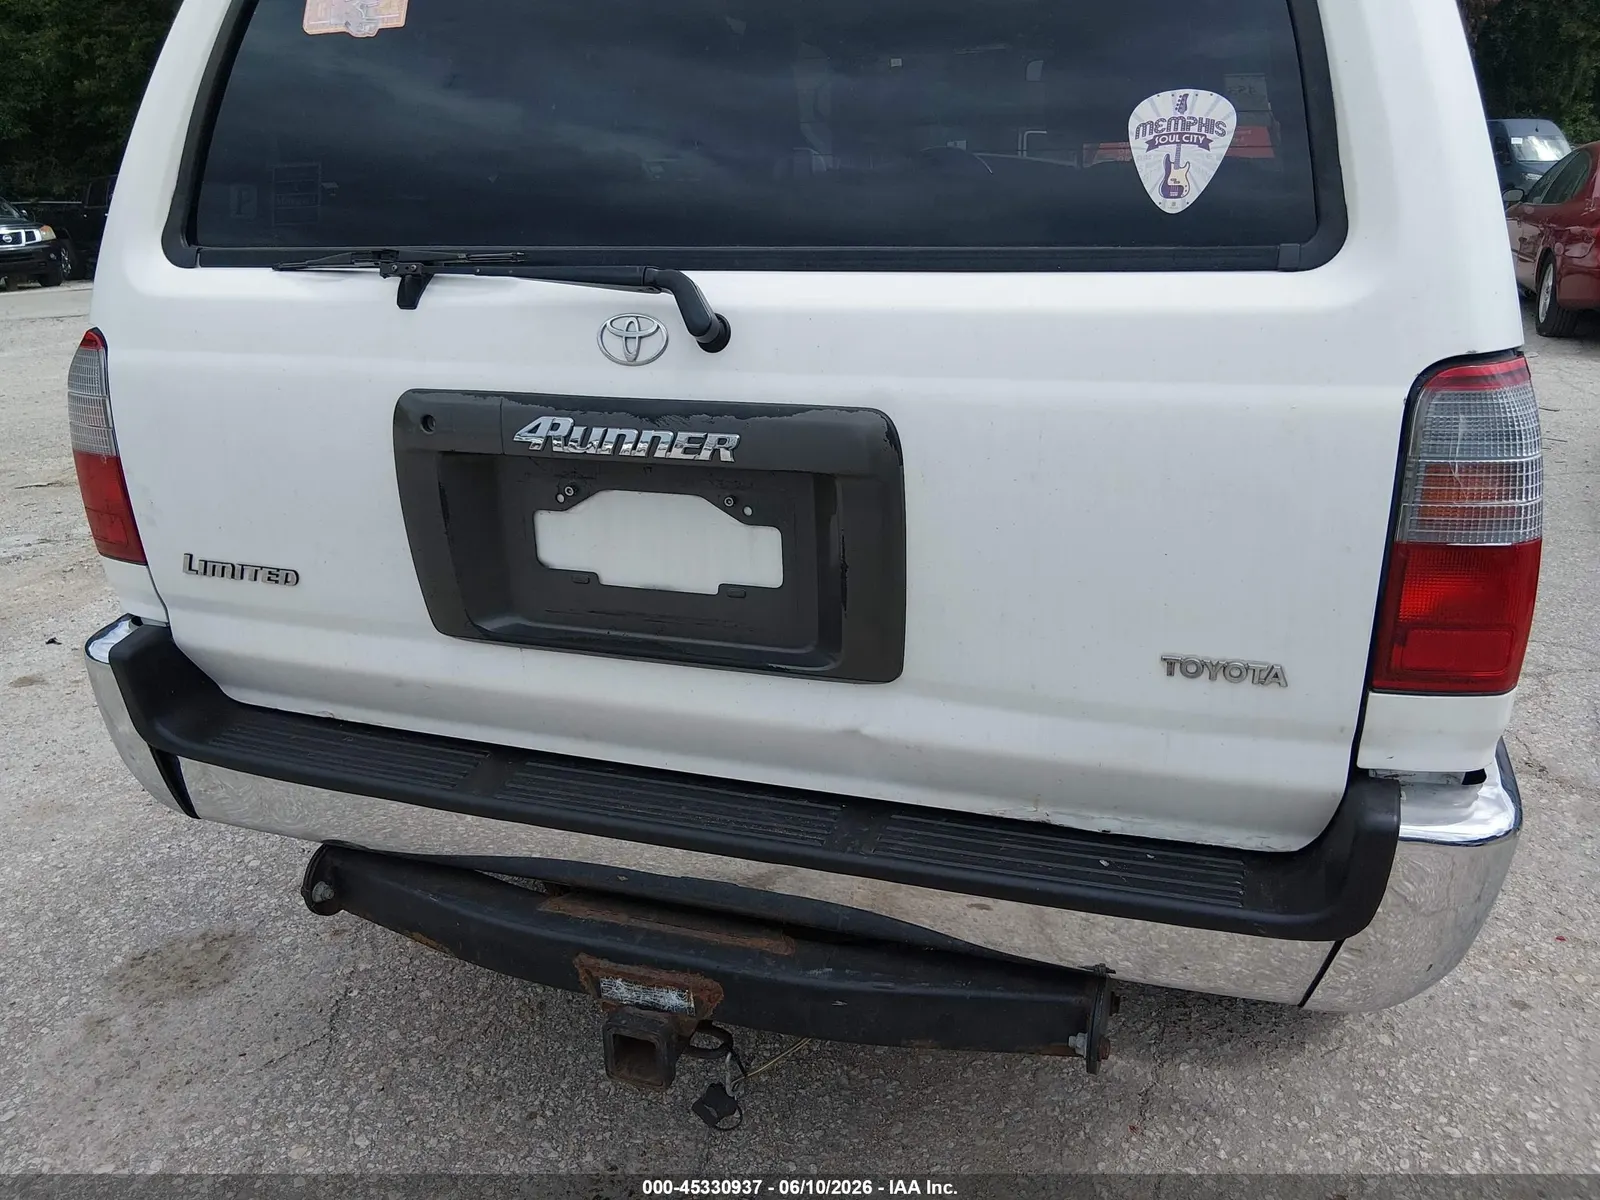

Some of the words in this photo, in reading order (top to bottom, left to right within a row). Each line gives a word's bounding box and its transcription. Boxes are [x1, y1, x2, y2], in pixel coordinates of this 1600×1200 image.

[1135, 115, 1227, 140] MEMPHIS
[1154, 134, 1180, 145] SOUL
[1182, 134, 1206, 143] CITY
[1161, 655, 1288, 687] TOYOTA
